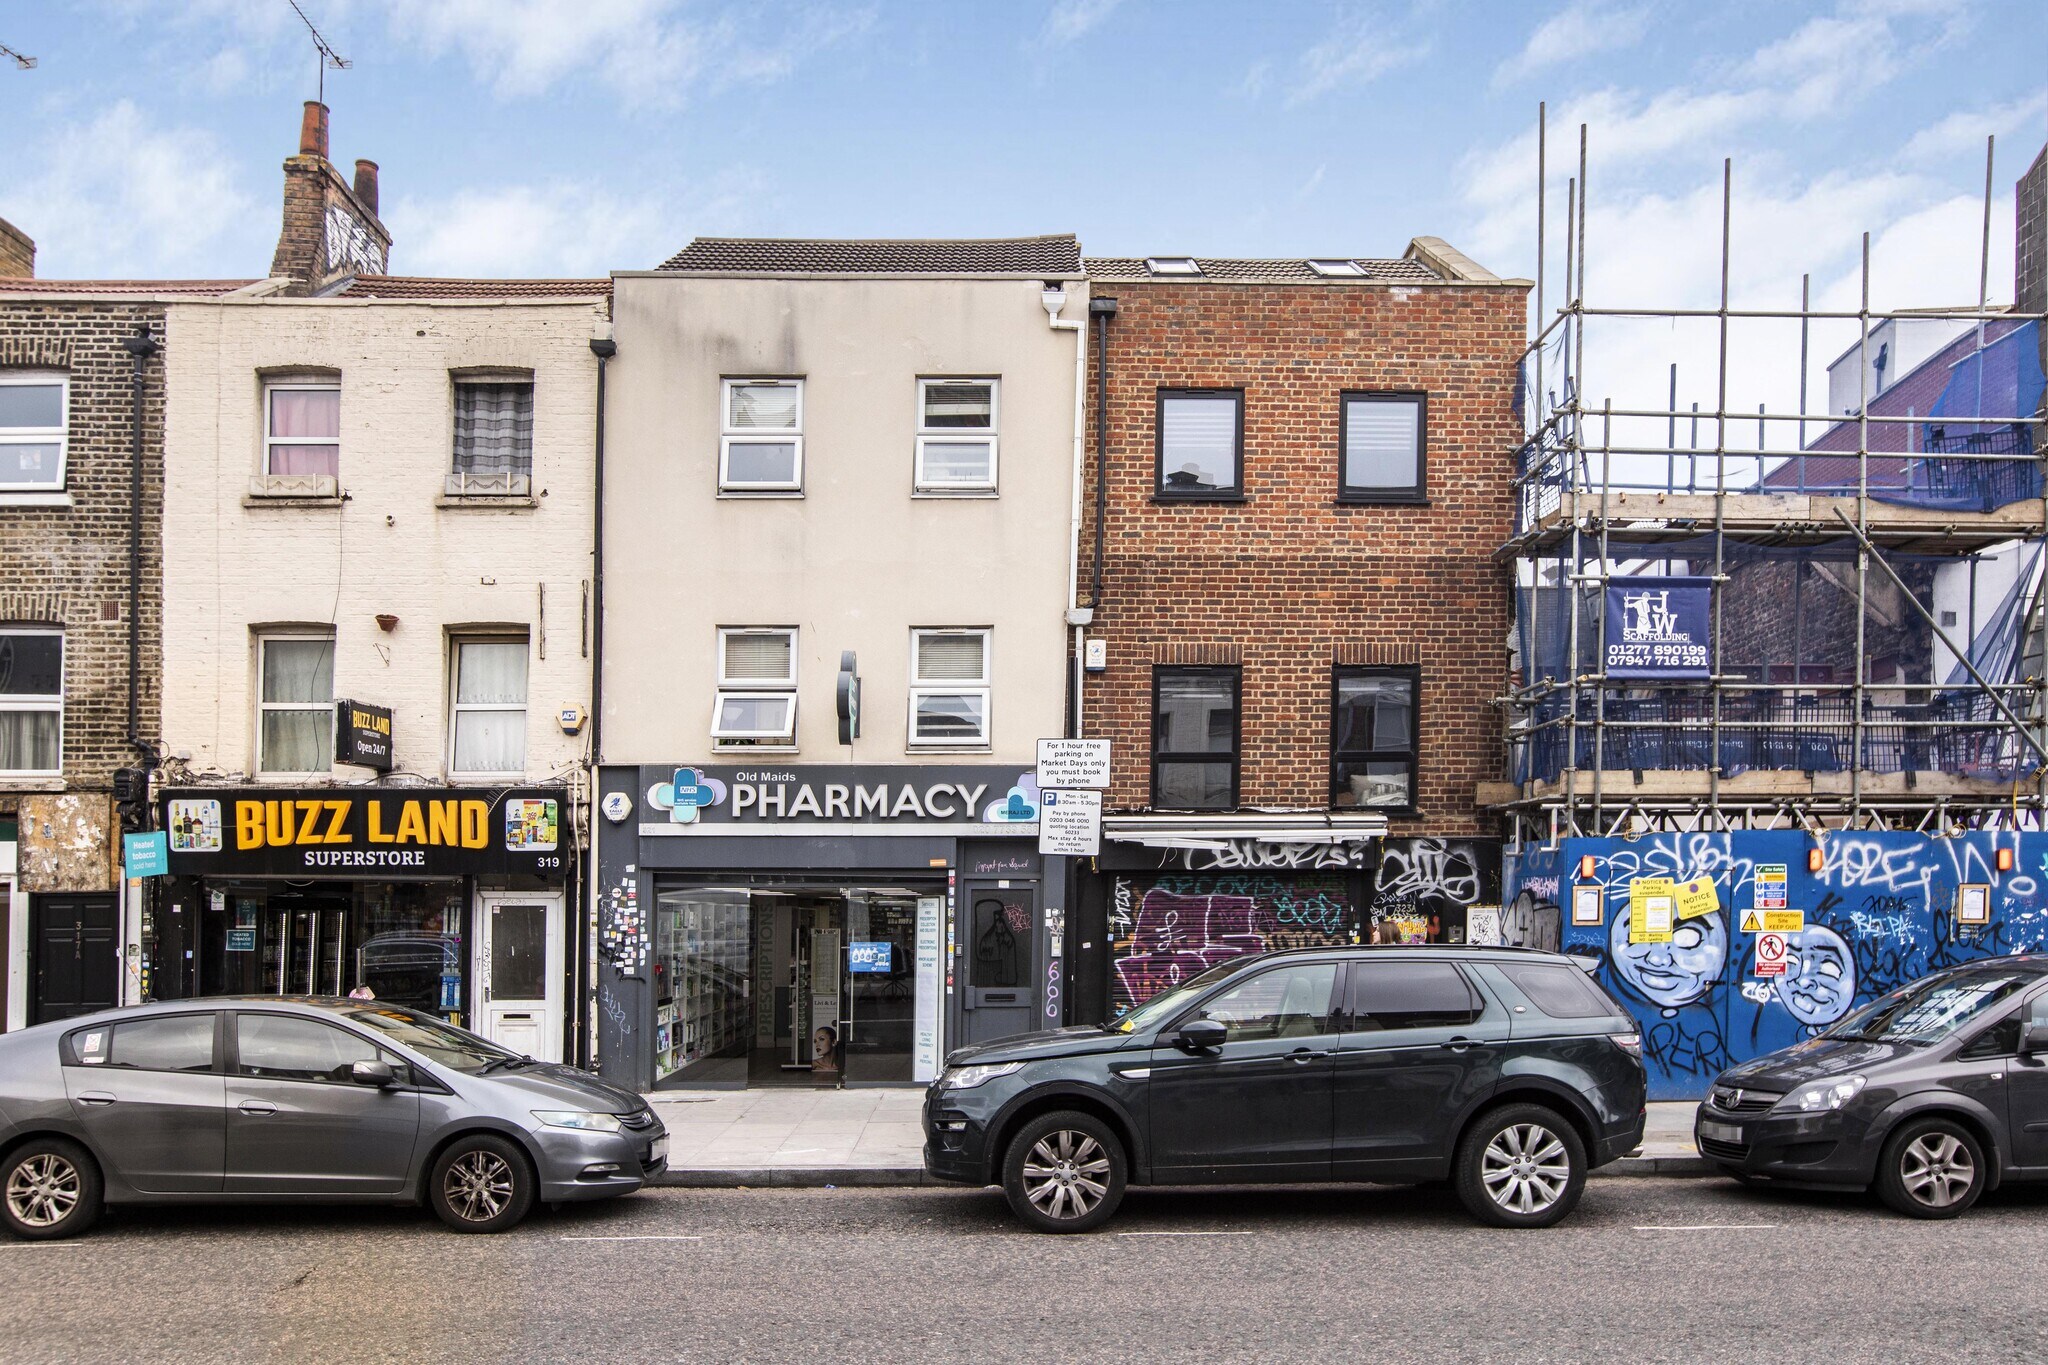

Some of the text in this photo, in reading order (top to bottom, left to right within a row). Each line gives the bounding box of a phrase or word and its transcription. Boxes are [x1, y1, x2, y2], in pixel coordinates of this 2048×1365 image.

[1652, 591, 1669, 613] J
[1652, 614, 1678, 635] W
[1623, 631, 1688, 641] SCAFFOLDING
[1609, 645, 1706, 656] 01277 890199
[1608, 656, 1708, 666] 07947 716 291
[562, 712, 576, 720] ADT
[353, 710, 390, 736] BUZZ LAND
[357, 740, 386, 756] Open 24/7
[736, 771, 797, 782] Old Maids
[680, 786, 698, 794] NHS
[732, 783, 988, 818] PHARMACY
[1044, 793, 1055, 805] P
[236, 800, 488, 850] BUZZ LAND
[133, 840, 155, 849] Heated
[132, 851, 157, 860] tobacco
[305, 851, 425, 866] SUPERSTORE
[537, 856, 560, 868] 319
[1683, 892, 1711, 905] NOTICE
[1396, 904, 1416, 912] 323A
[1687, 906, 1713, 916] suspension
[1690, 902, 1708, 910] Parking
[759, 903, 773, 1036] PRESCRIPTIONS
